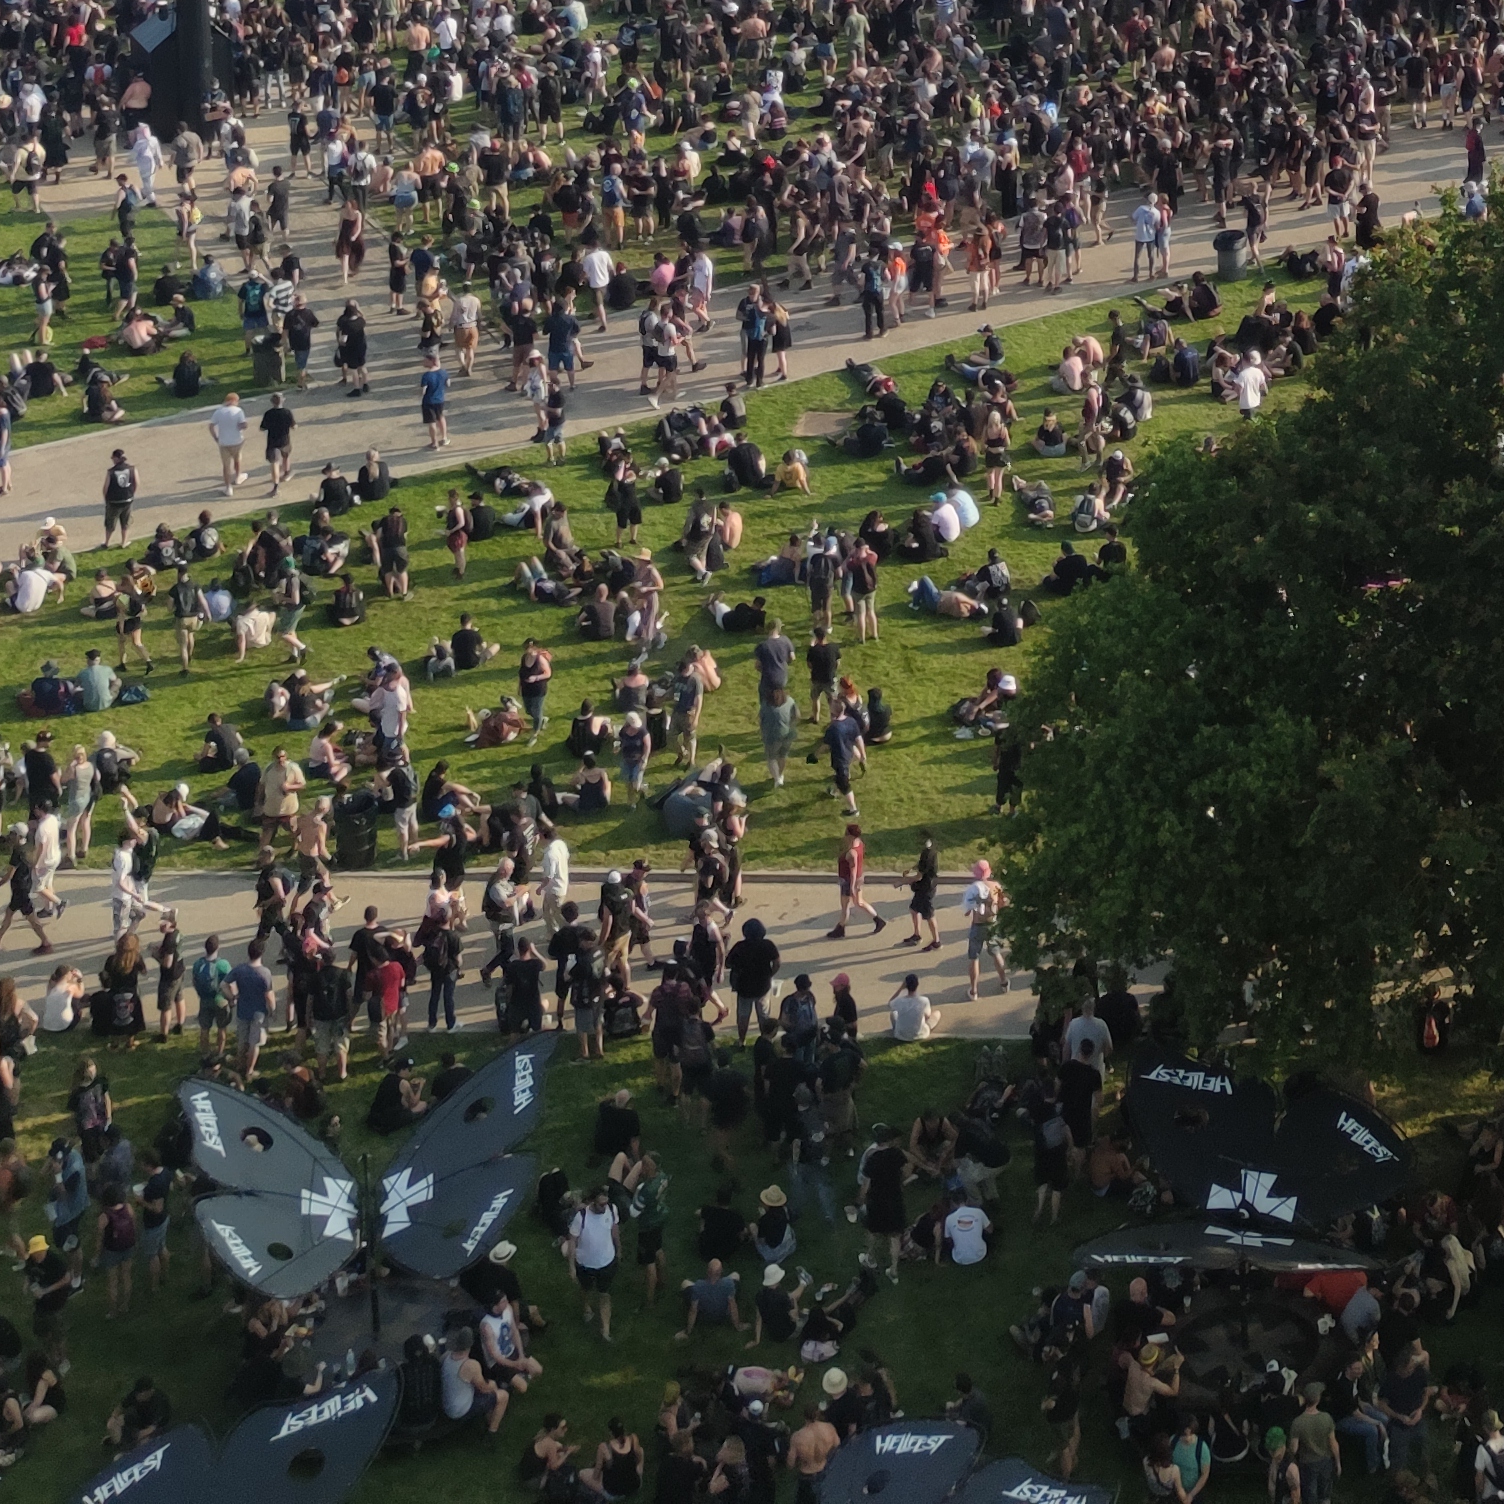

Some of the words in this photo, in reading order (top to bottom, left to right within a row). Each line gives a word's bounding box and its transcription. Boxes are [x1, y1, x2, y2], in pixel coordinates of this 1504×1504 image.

[1140, 1064, 1233, 1095] HELLFEST
[1336, 1110, 1400, 1163] HELLFEST
[876, 1433, 954, 1456] HELLFEST
